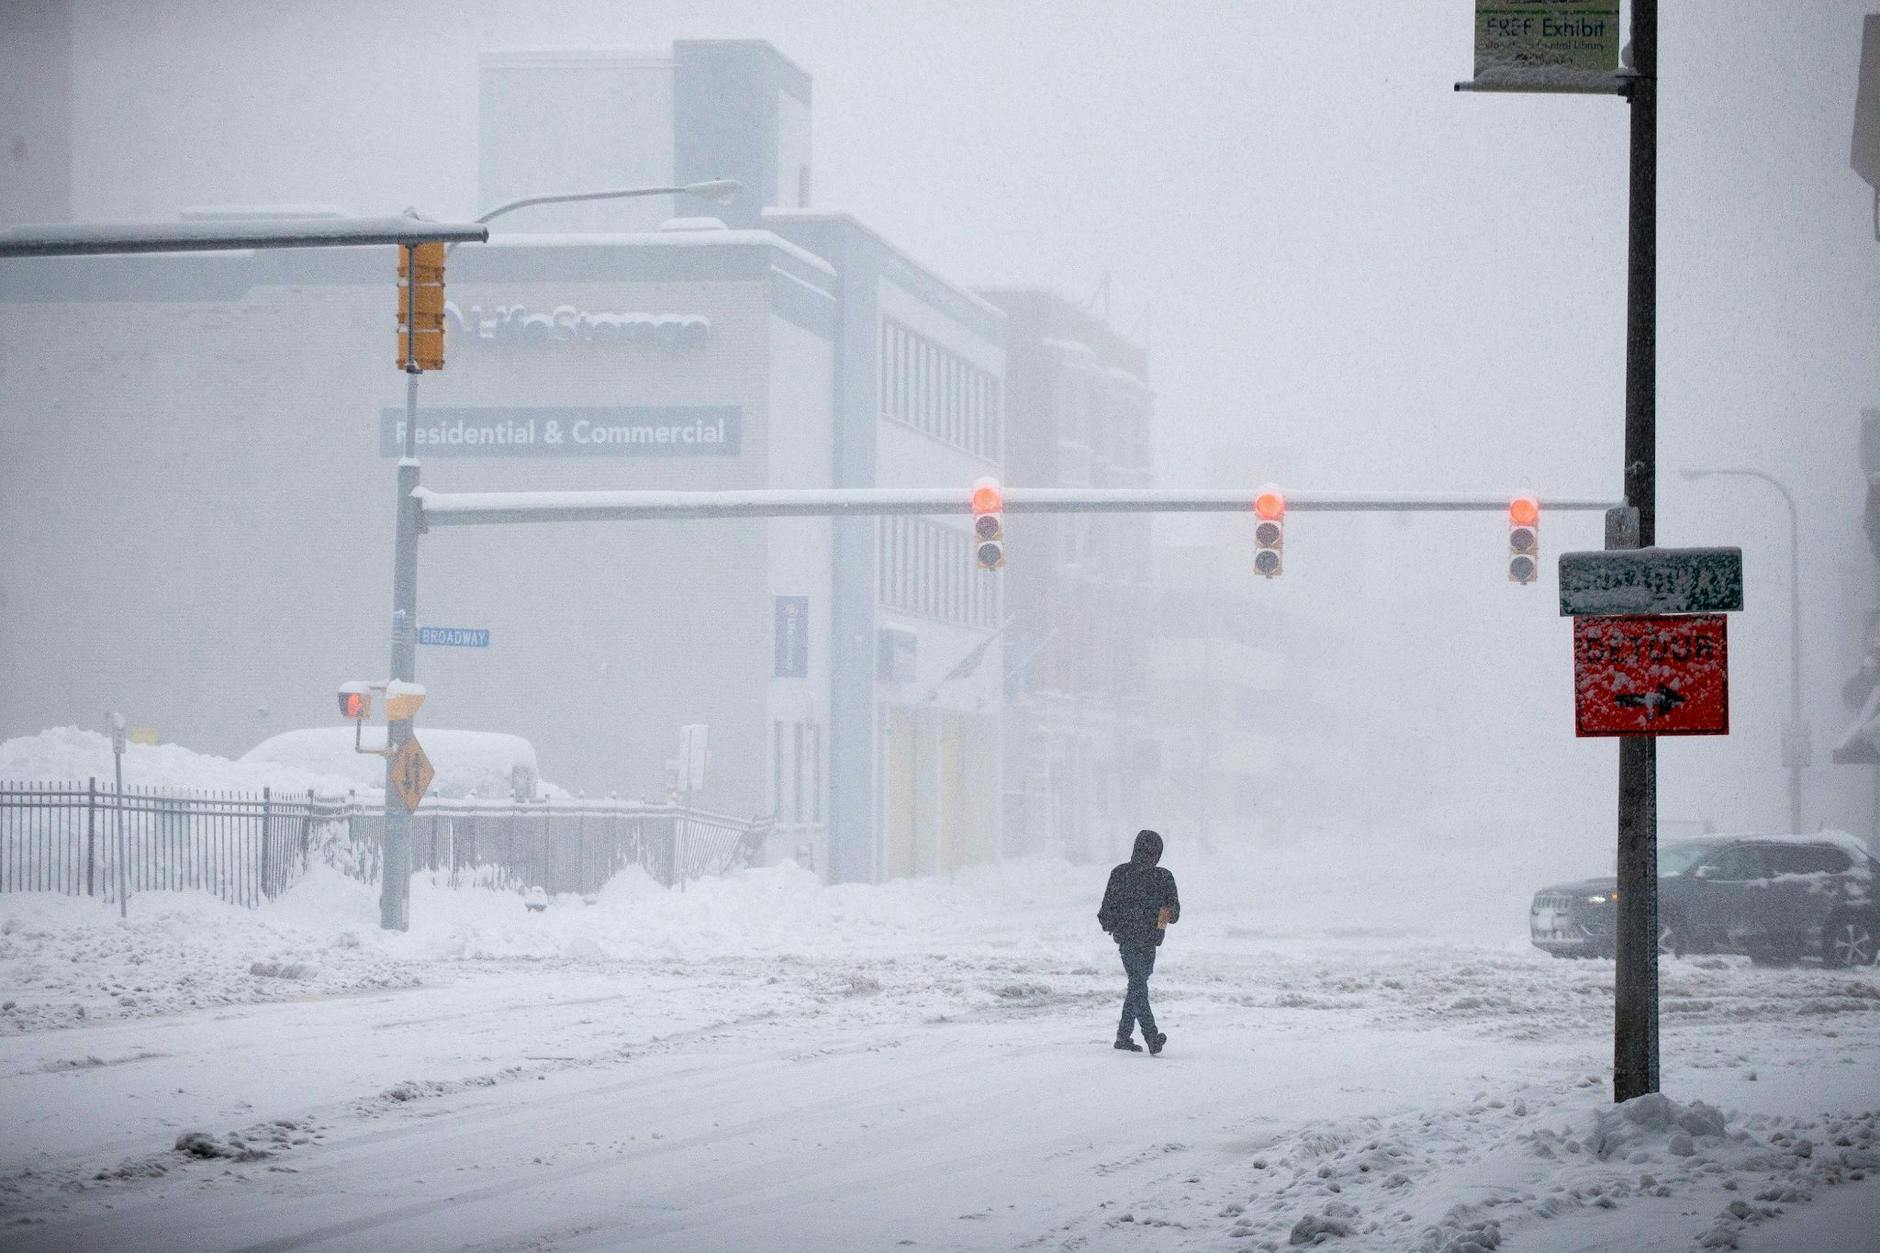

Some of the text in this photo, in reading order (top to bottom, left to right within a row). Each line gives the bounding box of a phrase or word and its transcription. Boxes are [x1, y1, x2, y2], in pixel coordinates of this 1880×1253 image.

[1542, 17, 1604, 37] Exhibit
[544, 420, 564, 444] &
[573, 418, 724, 444] Commercial
[422, 629, 486, 646] BROADWAY
[1586, 635, 1713, 663] DETOUR
